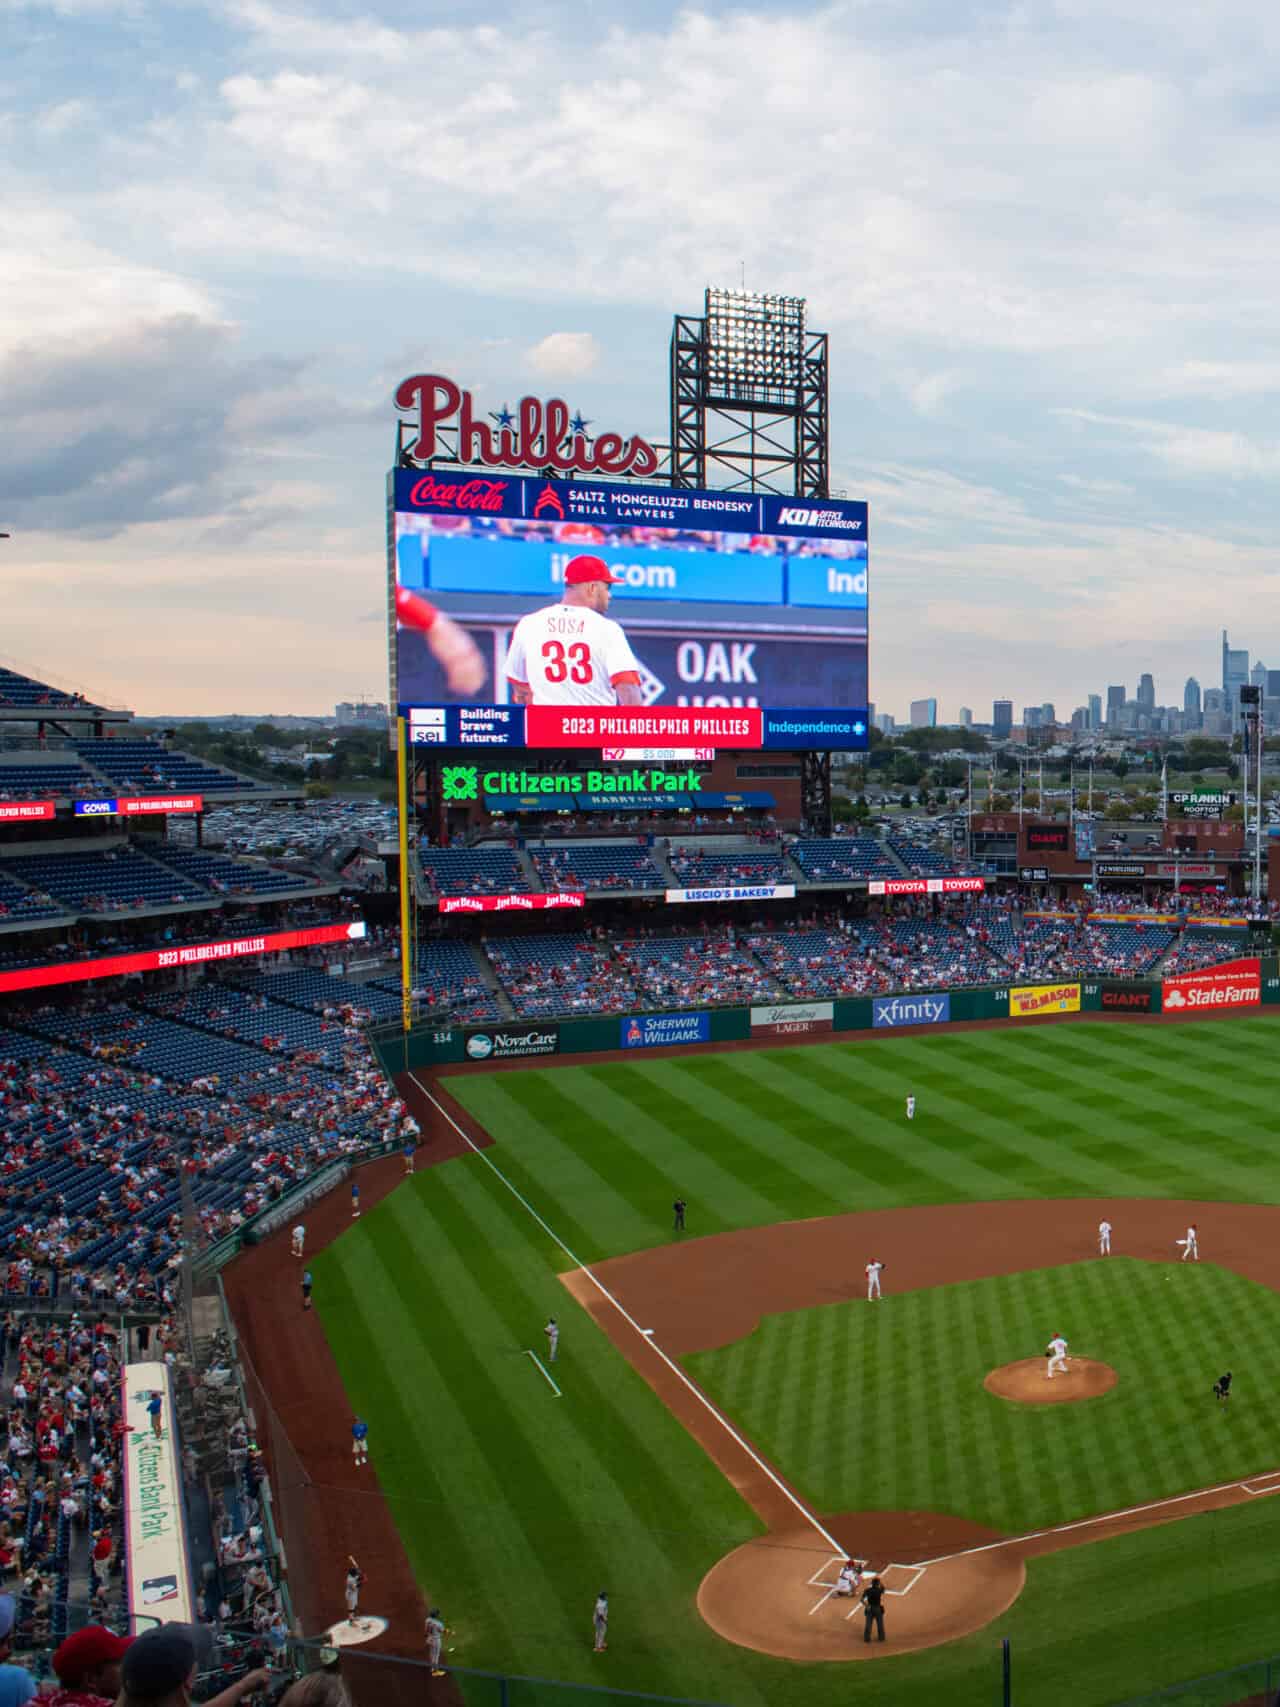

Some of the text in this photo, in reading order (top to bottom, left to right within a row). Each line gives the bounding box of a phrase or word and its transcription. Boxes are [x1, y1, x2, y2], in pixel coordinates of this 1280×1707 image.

[395, 374, 659, 477] Phillies
[568, 490, 753, 513] SALTZ MONGELUZZI BENDESKY
[568, 504, 675, 520] TRIAL LAWYERS
[547, 617, 585, 634] SOSA
[541, 640, 593, 684] 33
[677, 641, 758, 684] OAK
[460, 709, 509, 722] Building
[460, 721, 494, 731] brave
[562, 718, 750, 735] 2023 PHILADELPHIA PHILLIES
[768, 721, 851, 735] Independence
[483, 768, 702, 793] Citizens Bank Park
[83, 802, 110, 812] GOYA
[887, 882, 926, 892] TOYOTA
[944, 880, 983, 889] TOYOTA
[685, 887, 776, 900] LISCIO'S BAKERY
[158, 938, 265, 965] 2023 PHILADELPHIA PHILLIES
[1102, 994, 1150, 1006] GIANT
[877, 999, 944, 1026] xfinity
[646, 1017, 700, 1030] SHERWIN
[776, 1022, 809, 1033] LAGER
[433, 1033, 452, 1043] 334
[494, 1032, 557, 1048] NovaCare
[645, 1030, 699, 1044] WILLIAMS
[494, 1046, 555, 1057] REHABILITATION
[138, 1446, 171, 1540] Citizens Bank Park
